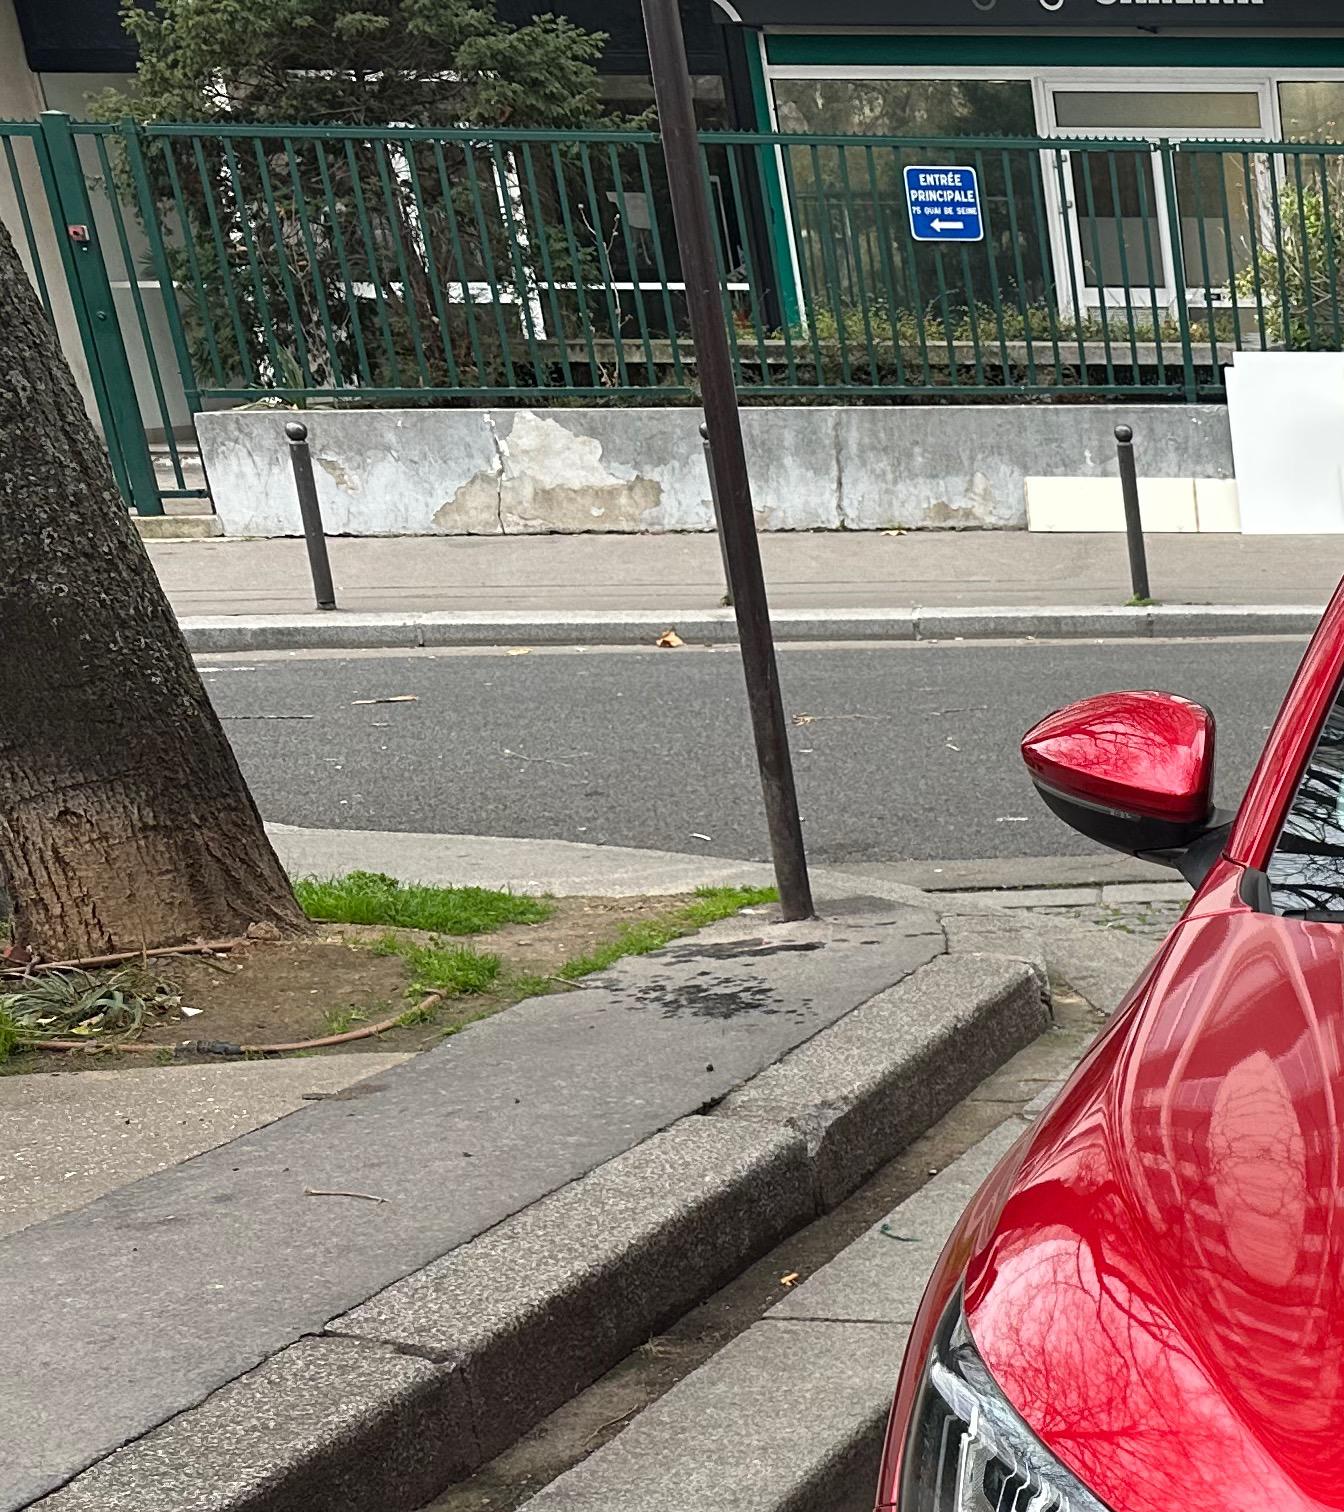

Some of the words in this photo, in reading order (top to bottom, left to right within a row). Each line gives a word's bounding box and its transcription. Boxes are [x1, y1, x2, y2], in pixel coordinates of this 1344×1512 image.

[918, 171, 962, 187] ENTRÉE
[910, 189, 975, 203] PRINCIPALE
[923, 206, 942, 216] QUAI
[943, 206, 954, 215] DE
